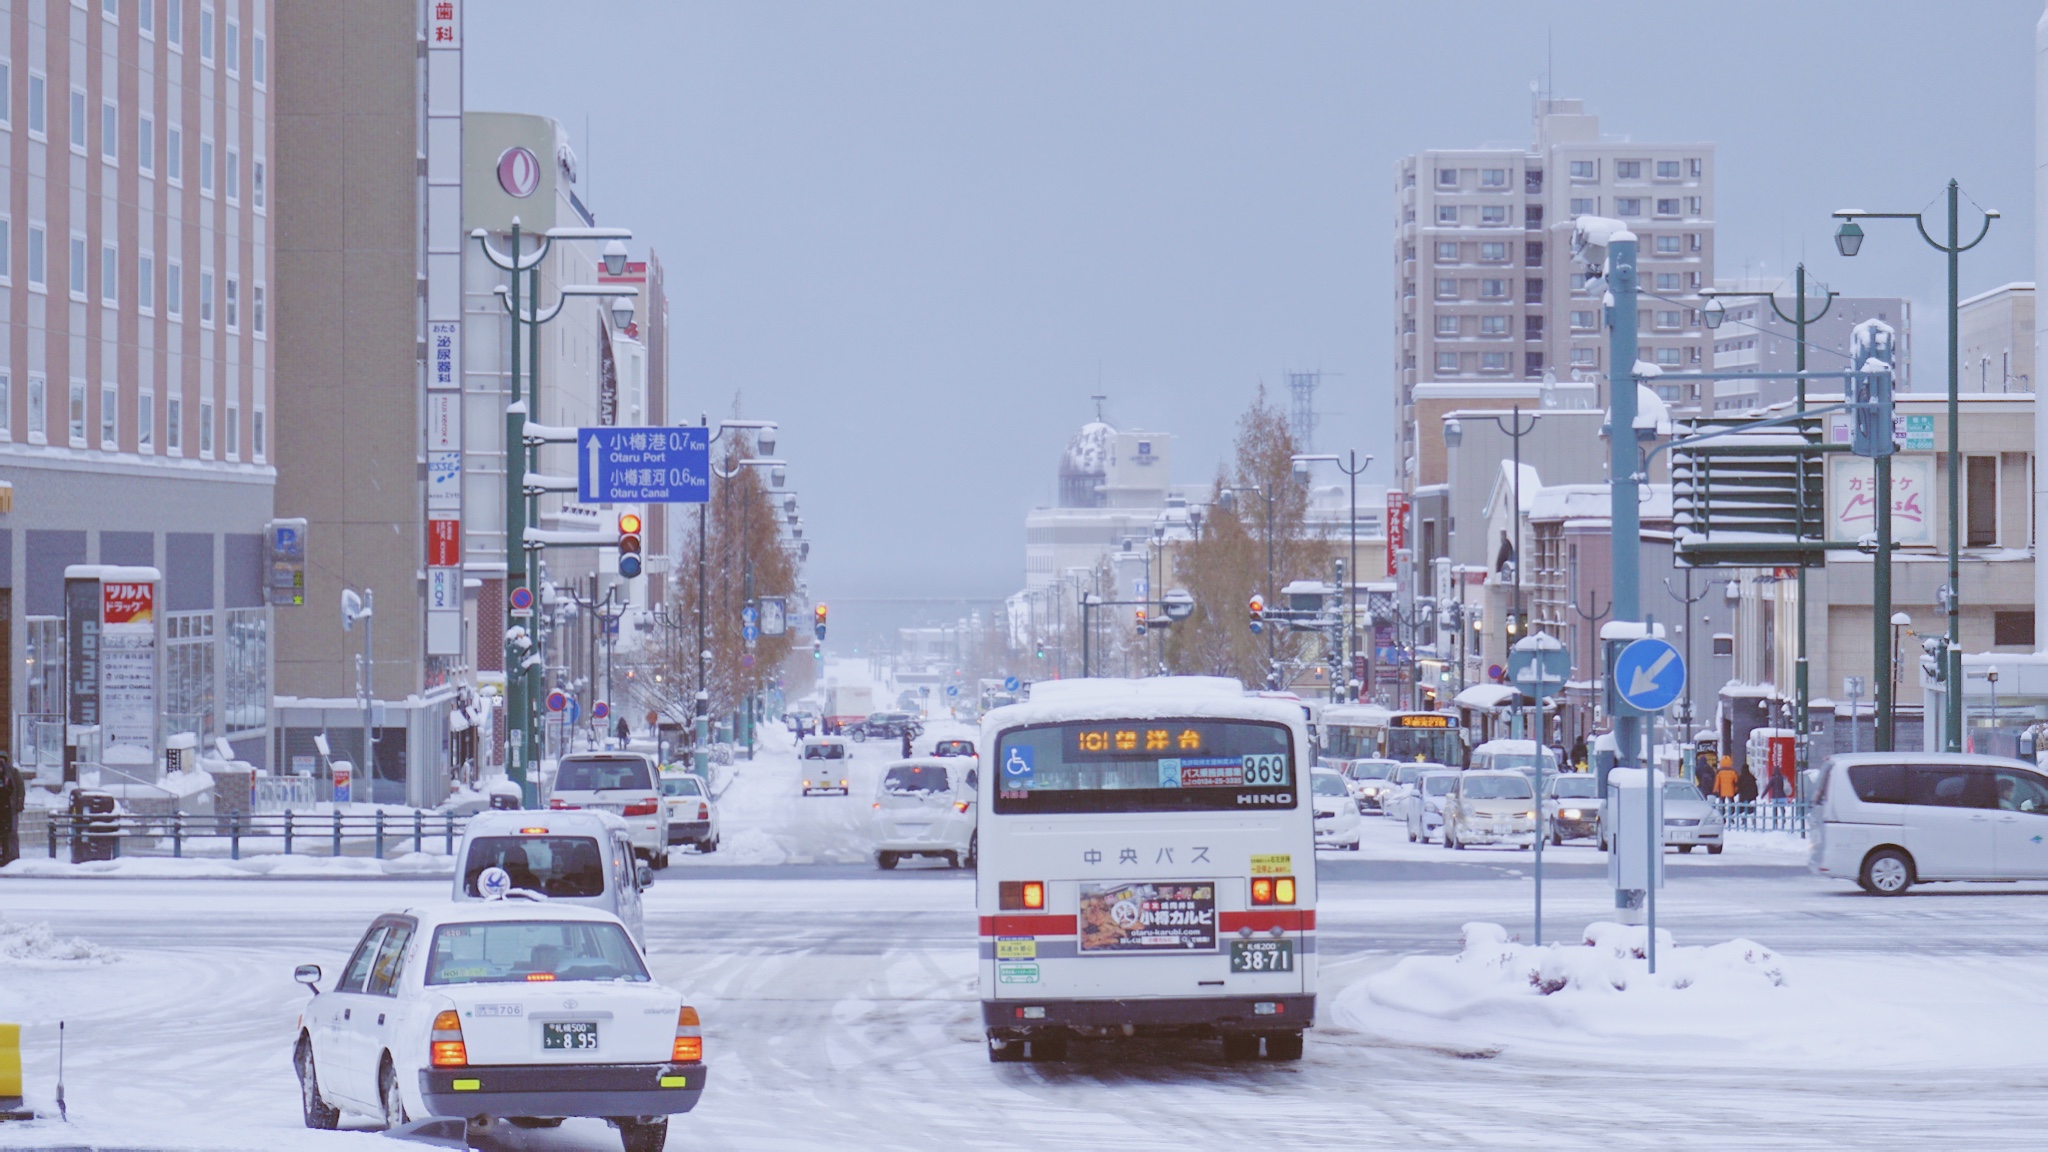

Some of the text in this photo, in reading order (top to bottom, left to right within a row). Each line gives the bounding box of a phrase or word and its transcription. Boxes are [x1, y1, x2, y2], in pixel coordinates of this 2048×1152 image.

[435, 2, 453, 42] 歯科
[437, 335, 451, 383] 泌尿器科
[610, 433, 667, 451] 小樽港
[610, 453, 665, 462] Otaru Port
[610, 469, 666, 487] 小樽運河
[1849, 477, 1913, 491] カラケ
[610, 488, 669, 498] Otaru Canal
[106, 585, 151, 599] ツルハ
[435, 572, 444, 607] SECOM
[106, 601, 143, 612] ドラッグ
[75, 621, 99, 694] dormy
[1080, 730, 1201, 751] 101 望洋台
[1245, 756, 1283, 783] 869
[1237, 793, 1292, 804] HINO
[1084, 847, 1211, 866] 中央バス
[1140, 909, 1213, 925] 小樽カルビ
[1131, 928, 1200, 937] otaru-karubi.com
[1242, 951, 1288, 970] 38-71
[500, 1005, 520, 1014] 706
